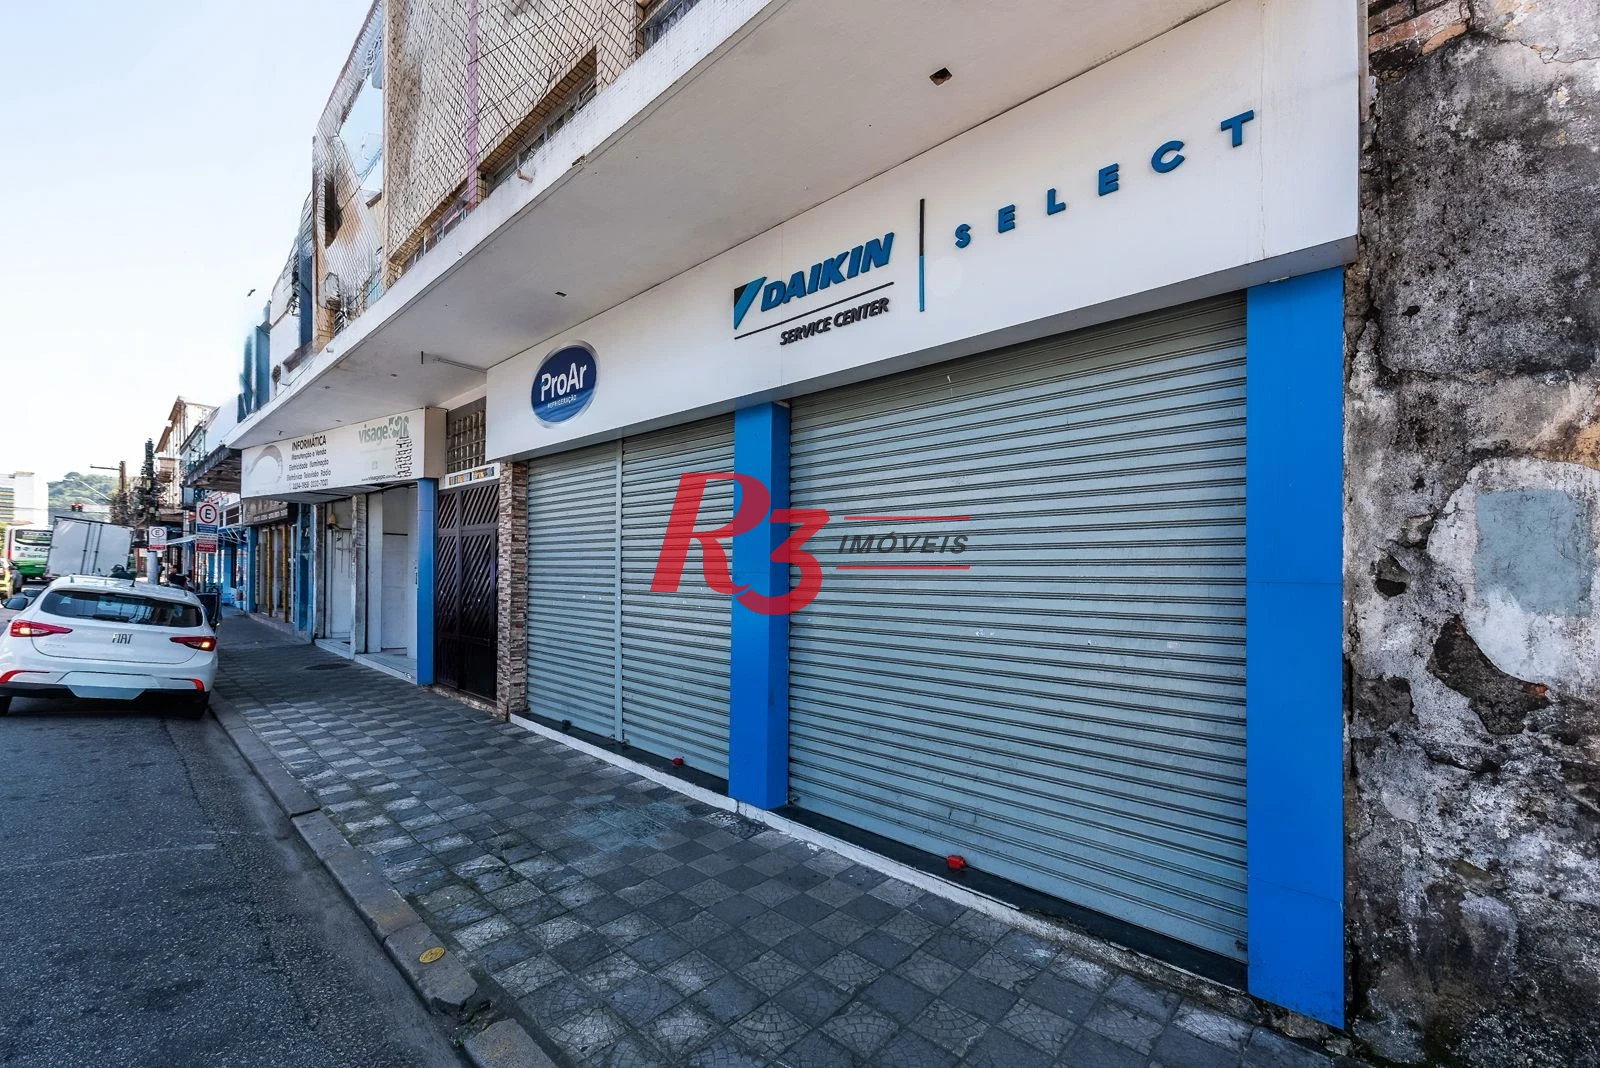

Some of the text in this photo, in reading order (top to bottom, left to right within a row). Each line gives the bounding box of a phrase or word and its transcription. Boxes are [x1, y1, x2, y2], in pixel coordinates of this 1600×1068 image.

[954, 109, 1255, 249] SELECT
[761, 231, 895, 312] DAIKIN
[779, 297, 890, 346] SERVICE CENTER
[540, 362, 587, 402] ProAr
[291, 434, 327, 451] INFORMÁTICA
[205, 508, 212, 520] E
[111, 633, 134, 645] FIAT
